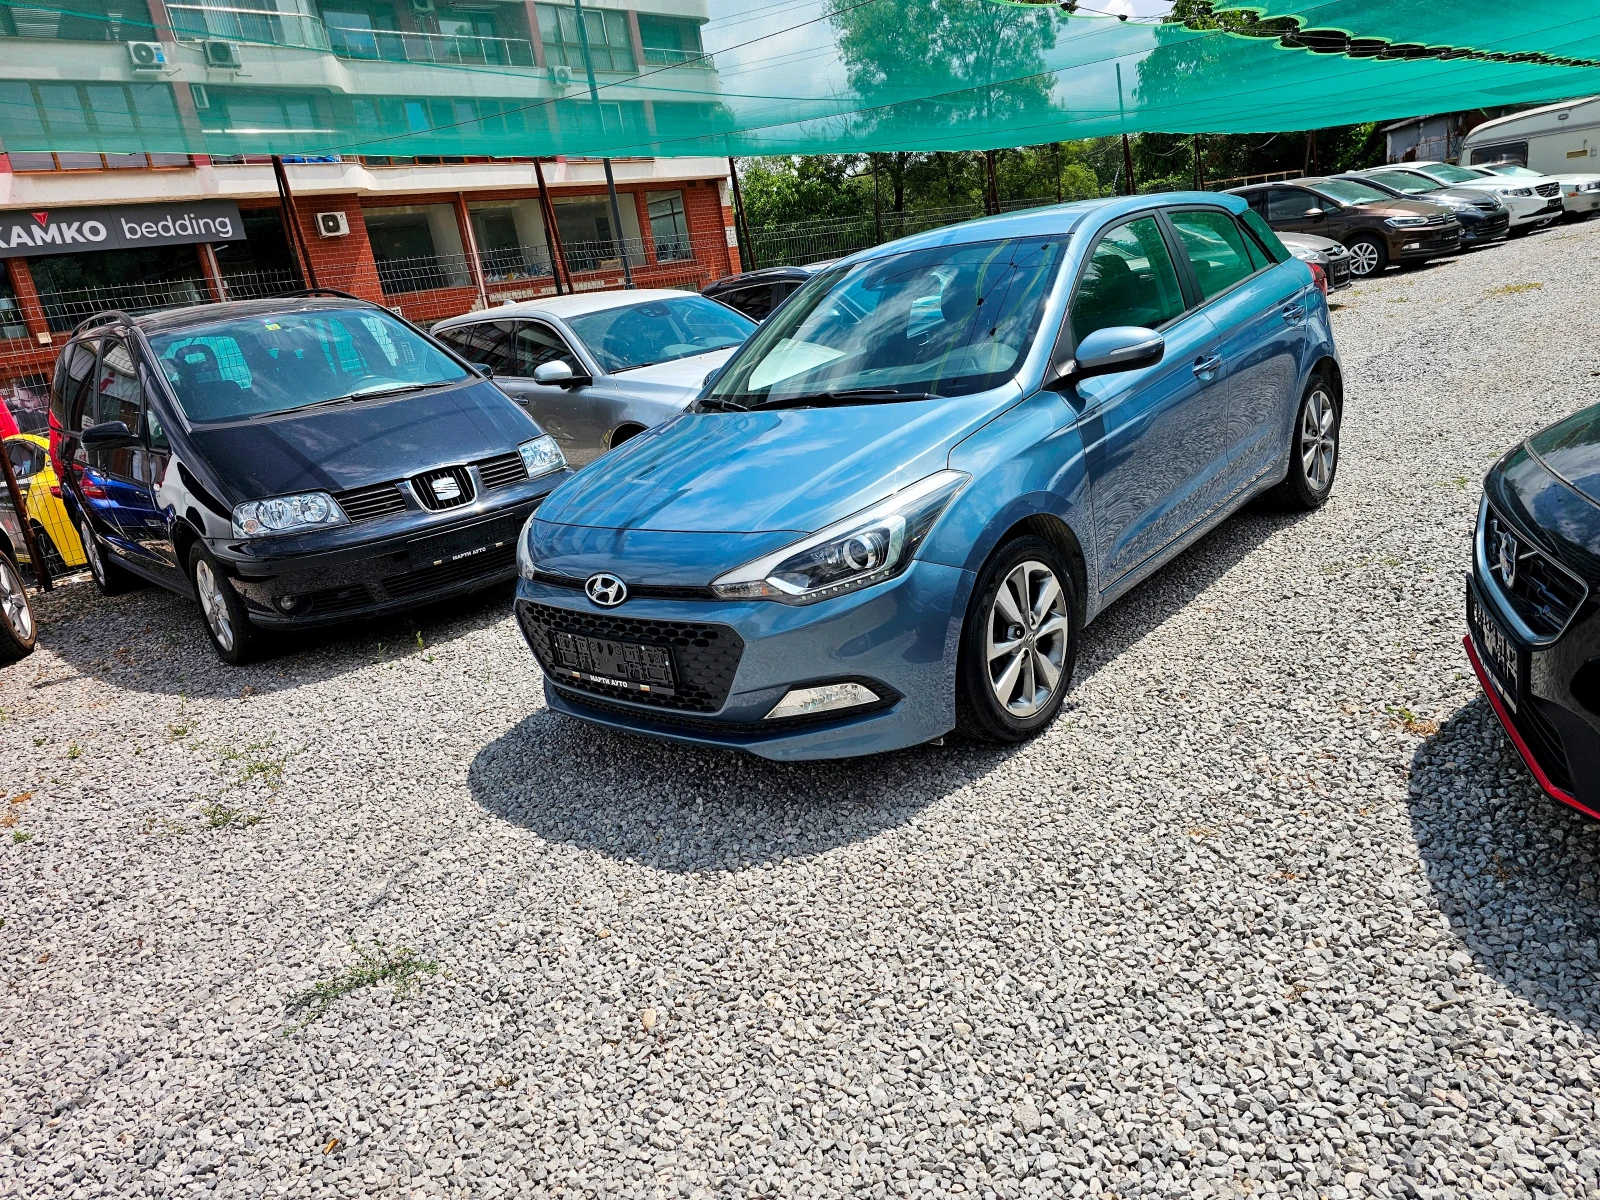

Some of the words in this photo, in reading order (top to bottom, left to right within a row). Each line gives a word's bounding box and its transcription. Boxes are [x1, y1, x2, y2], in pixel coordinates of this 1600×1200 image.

[120, 213, 233, 239] bedding
[589, 674, 610, 685] МАРТИ
[611, 680, 628, 688] АУТО
